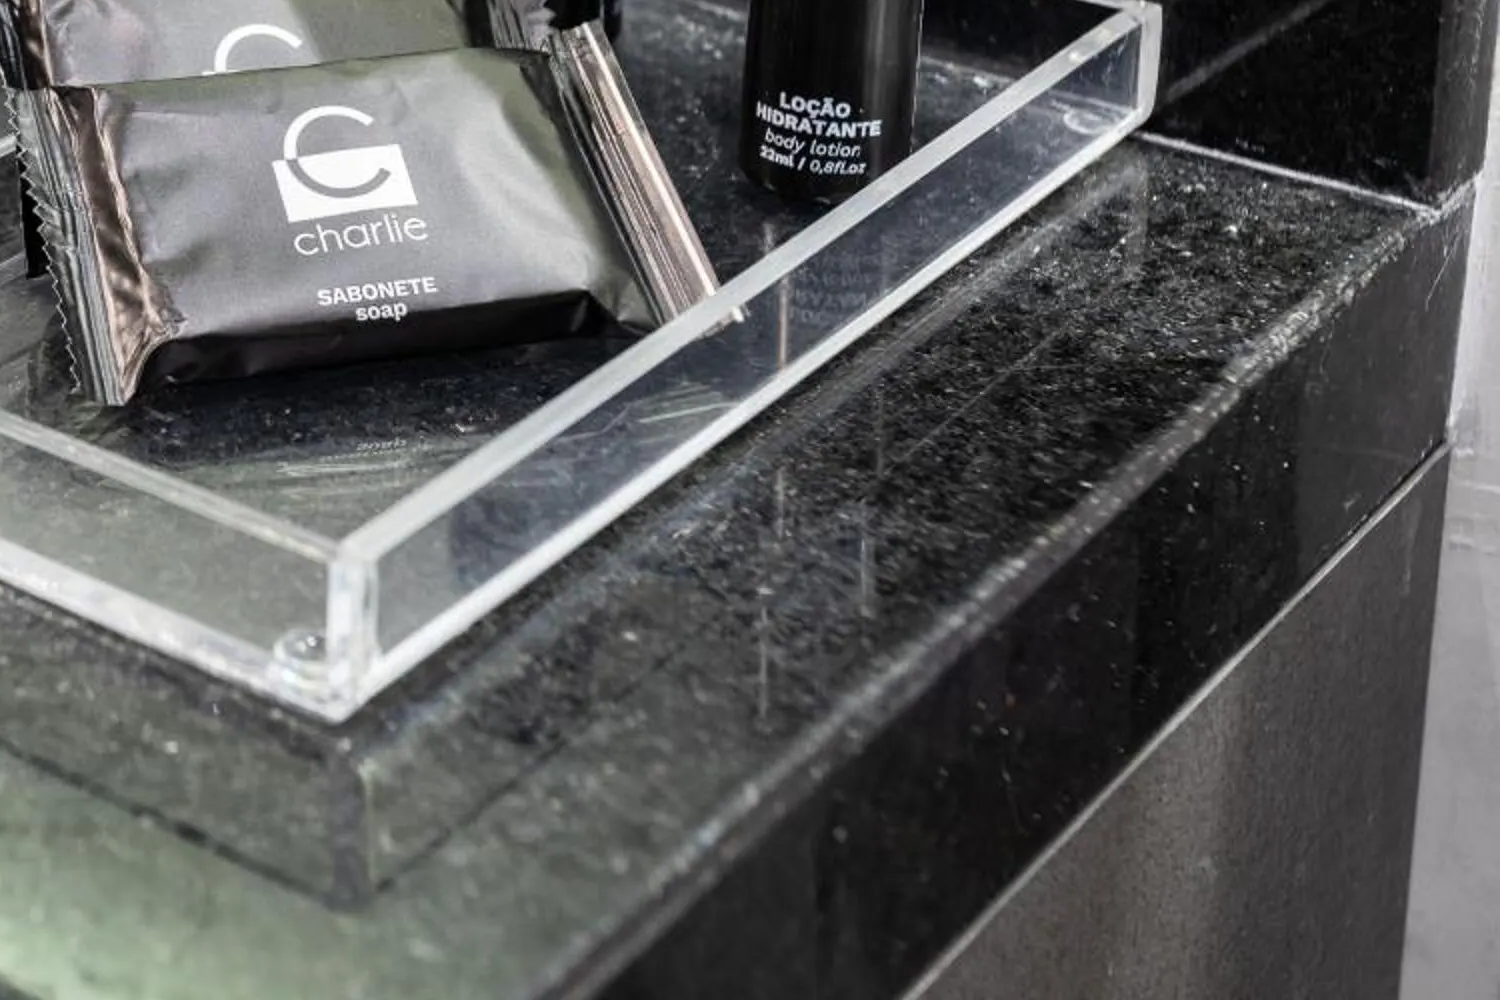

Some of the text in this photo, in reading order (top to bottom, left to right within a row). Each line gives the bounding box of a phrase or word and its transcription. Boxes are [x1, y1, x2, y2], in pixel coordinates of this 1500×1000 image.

[756, 101, 883, 138] HIDRATANTE
[779, 91, 851, 119] LOÇÃO
[765, 127, 861, 158] body lotion
[293, 212, 430, 257] charlie
[316, 276, 438, 306] SABONETE
[355, 301, 409, 324] soap
